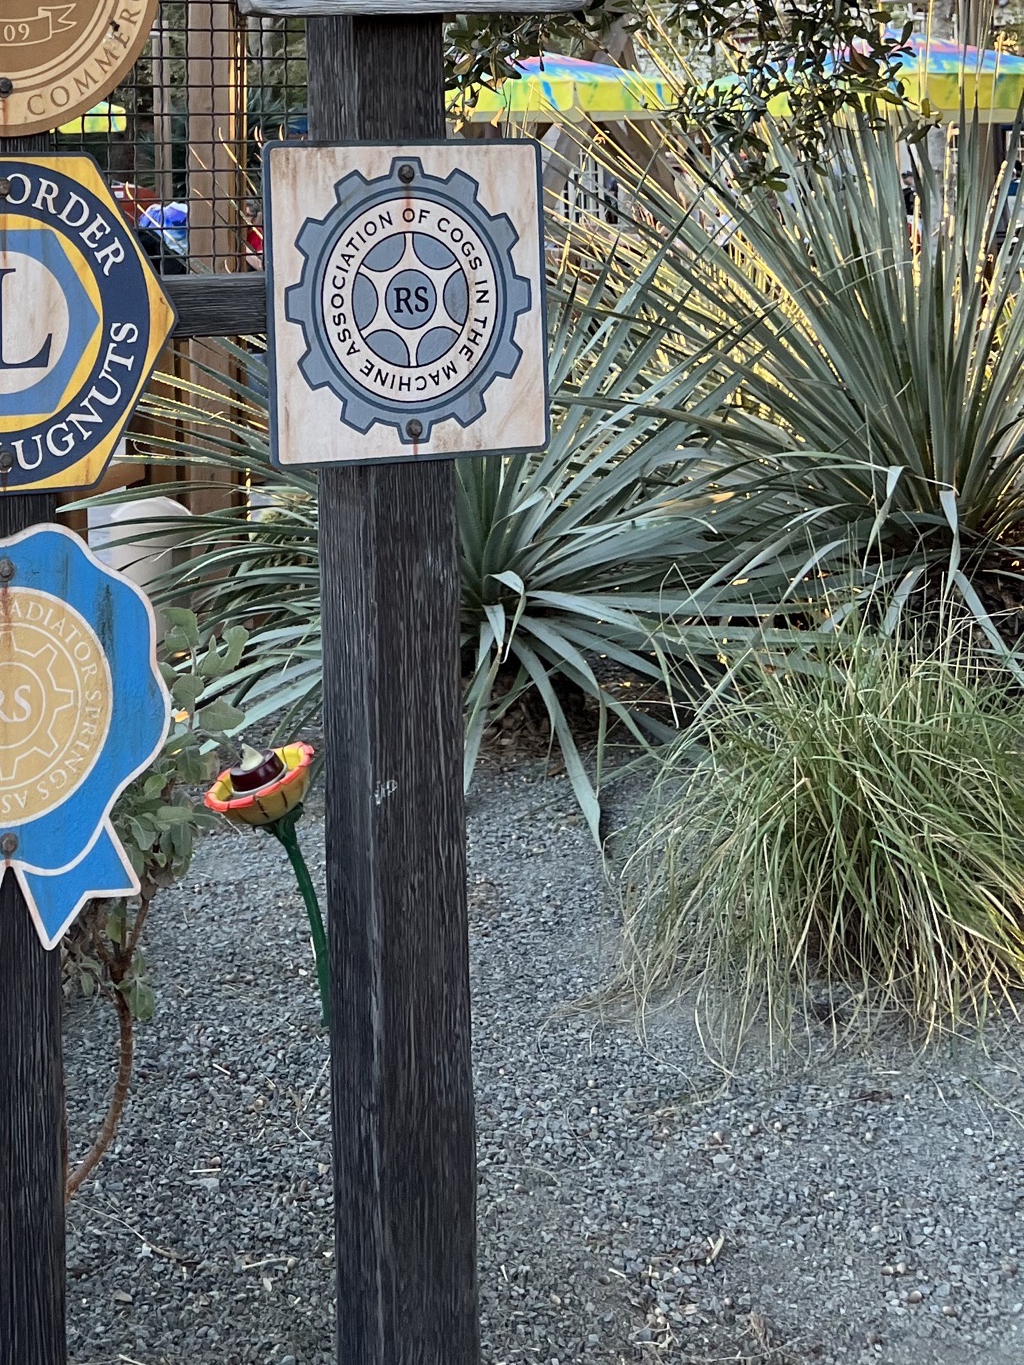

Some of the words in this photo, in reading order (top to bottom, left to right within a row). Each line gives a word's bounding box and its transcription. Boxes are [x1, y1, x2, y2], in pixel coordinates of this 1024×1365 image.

[2, 173, 125, 276] ORDER
[402, 208, 430, 224] OF
[437, 216, 482, 271] COGS
[330, 211, 393, 357] ASSOCIATION
[393, 286, 430, 315] RS
[474, 280, 490, 304] IN
[458, 316, 488, 362] THE
[360, 360, 459, 392] MACHINE
[36, 690, 102, 800] SPRINGS
